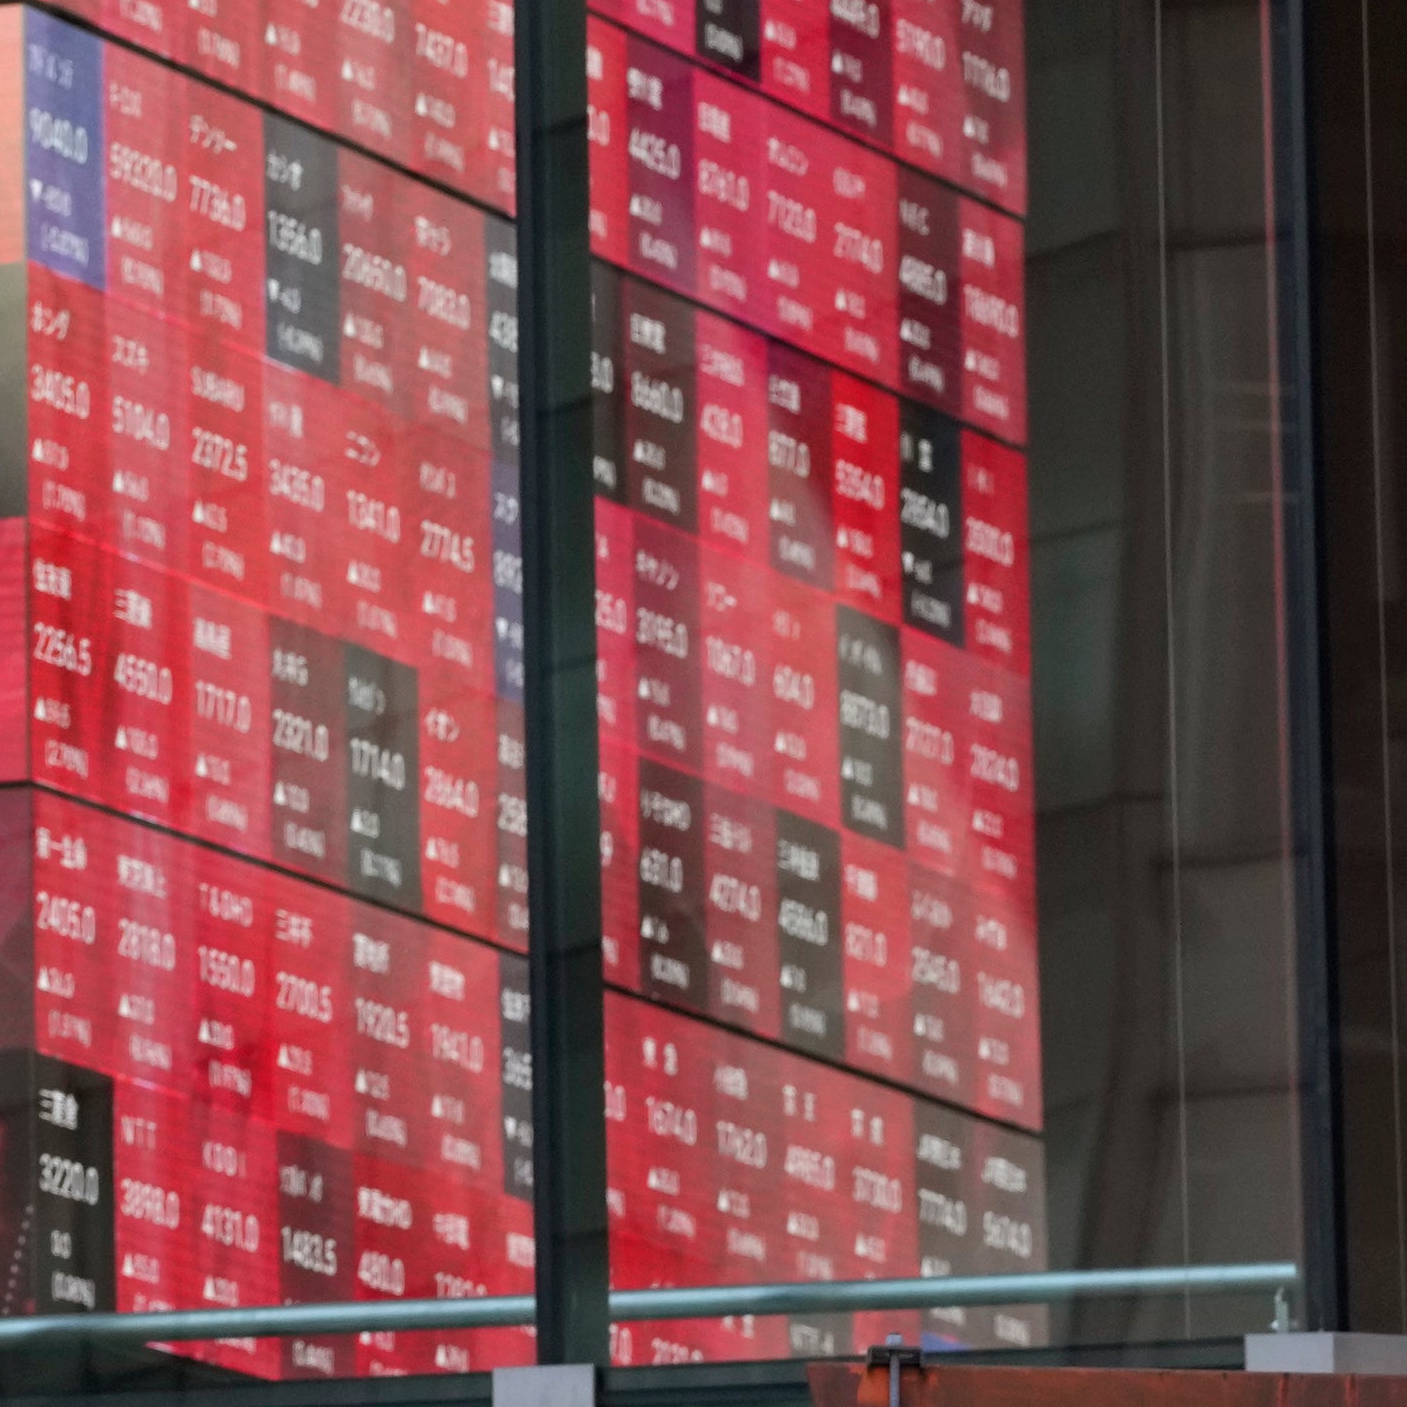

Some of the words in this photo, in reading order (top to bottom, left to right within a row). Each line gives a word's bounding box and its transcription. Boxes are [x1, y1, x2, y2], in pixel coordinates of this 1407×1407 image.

[268, 210, 322, 265] 1356.0
[34, 621, 92, 676] 2256.5
[195, 680, 252, 734] 1717.0
[350, 738, 405, 790] 1714.0
[201, 1204, 259, 1253] 4131.0
[281, 1226, 337, 1276] 1483.5
